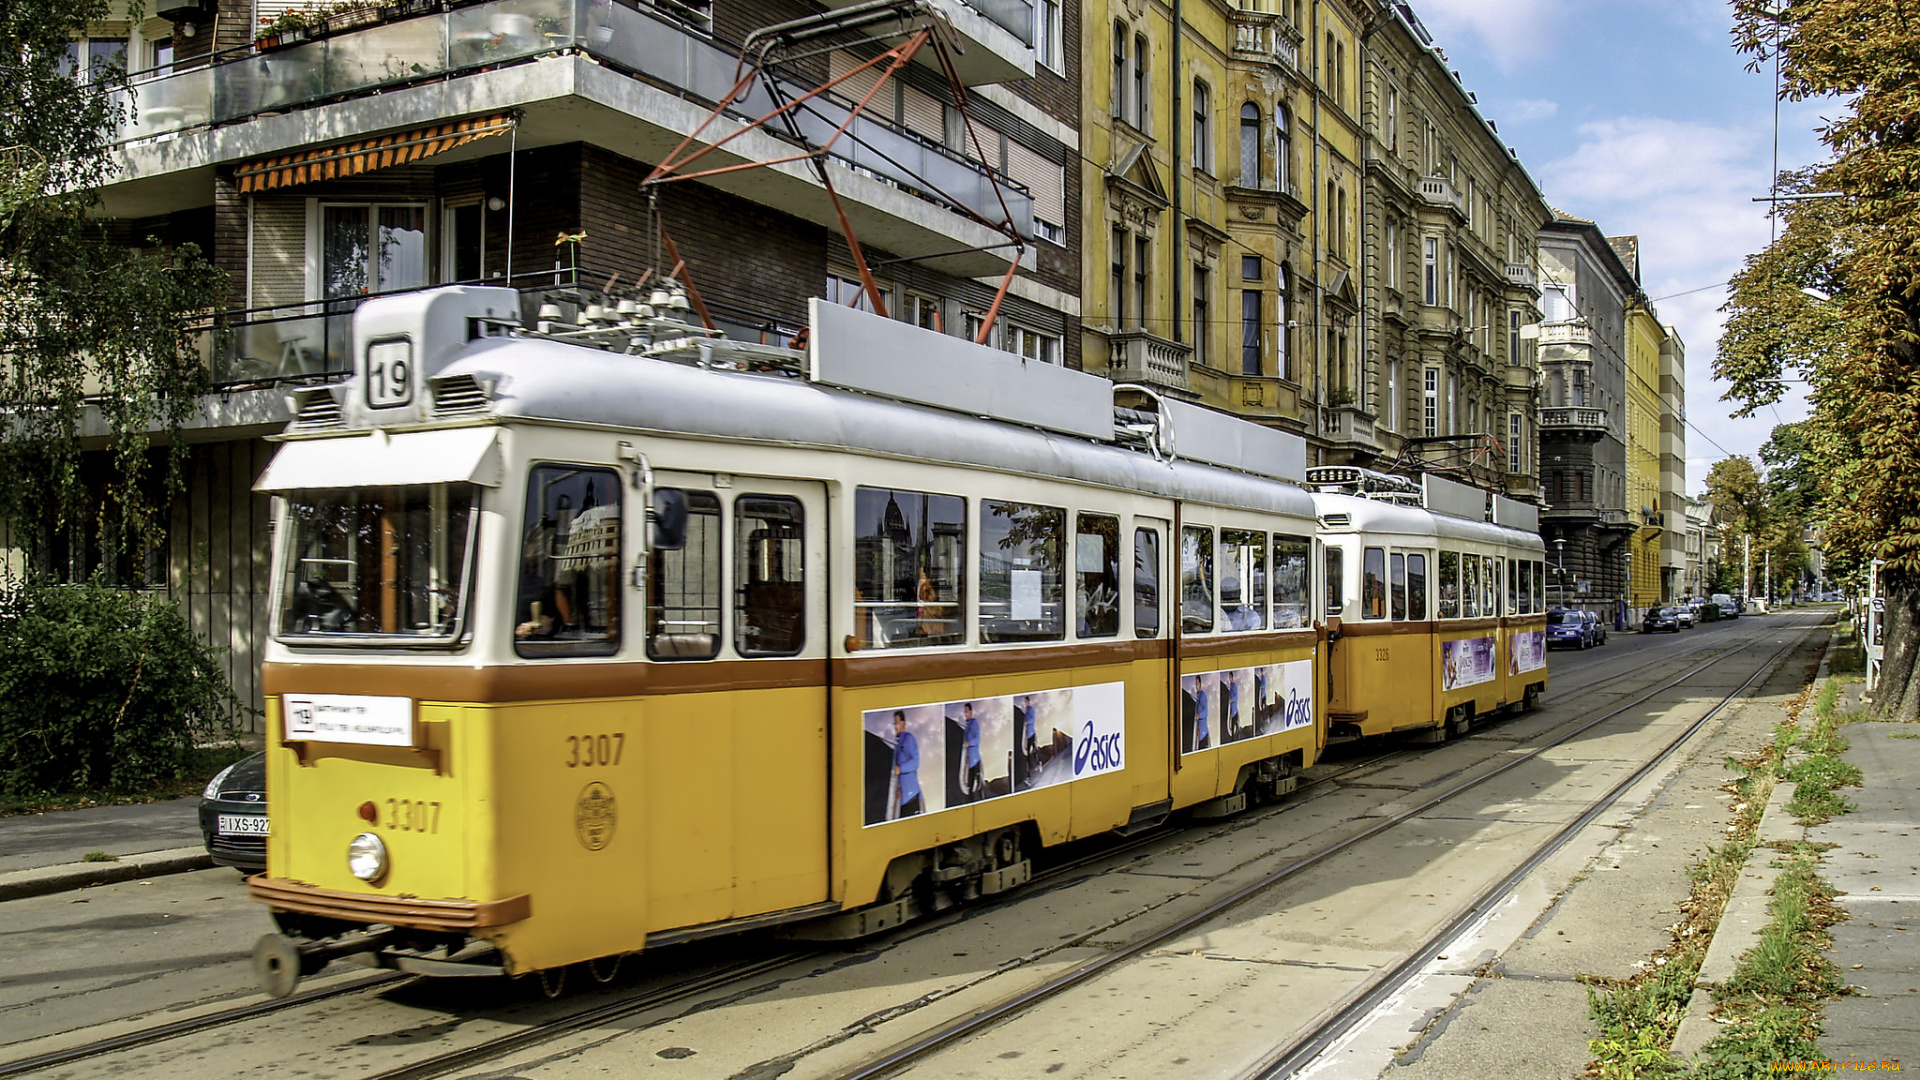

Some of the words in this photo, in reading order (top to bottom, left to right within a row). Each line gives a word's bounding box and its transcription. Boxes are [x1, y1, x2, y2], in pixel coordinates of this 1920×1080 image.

[371, 360, 407, 398] 19
[292, 708, 313, 725] 19
[565, 732, 626, 768] 3307
[228, 818, 271, 832] IXS-927
[385, 797, 442, 835] 3307
